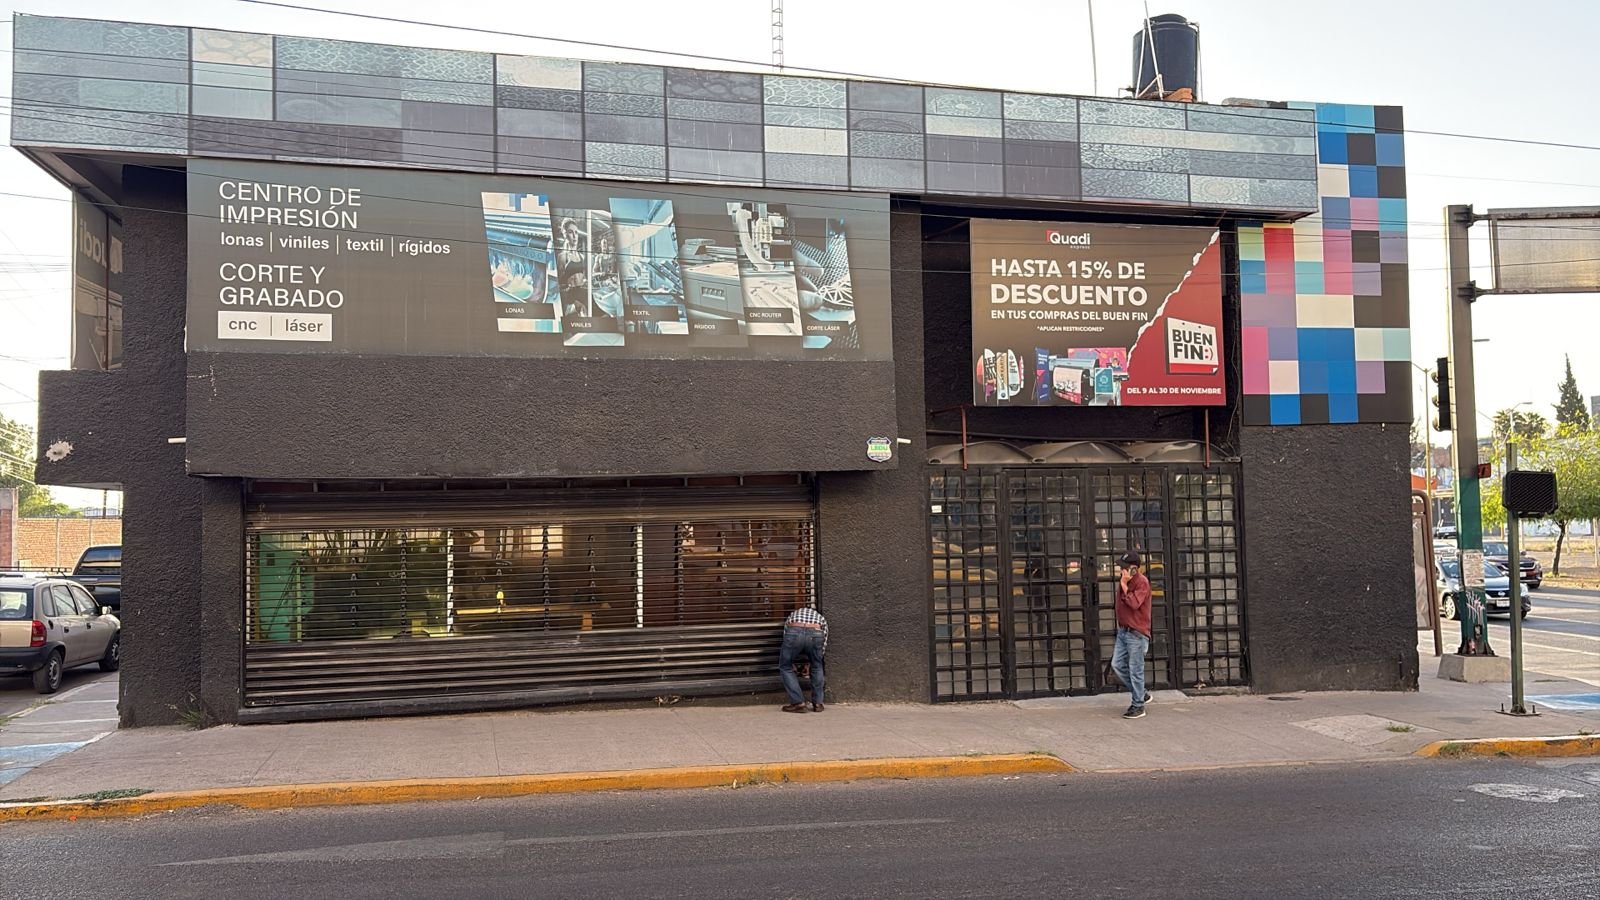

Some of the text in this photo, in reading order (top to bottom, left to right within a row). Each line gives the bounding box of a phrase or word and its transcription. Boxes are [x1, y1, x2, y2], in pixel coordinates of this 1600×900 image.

[219, 181, 361, 207] CENTRO DE
[219, 205, 358, 229] IMPRESIÓN
[220, 232, 451, 256] lonas viniles textil rígidos
[1050, 232, 1091, 245] Quadi
[219, 262, 326, 284] CORTE Y
[991, 258, 1146, 280] HASTA 15% DE
[219, 287, 344, 309] GRABADO
[991, 283, 1148, 306] DESCUENTO
[228, 318, 324, 334] cnc láser
[991, 309, 1148, 321] EN TUS COMPRAS DEL BUEN FIN
[1172, 328, 1213, 346] BUEN
[1180, 387, 1222, 395] NOVIEMBRE
